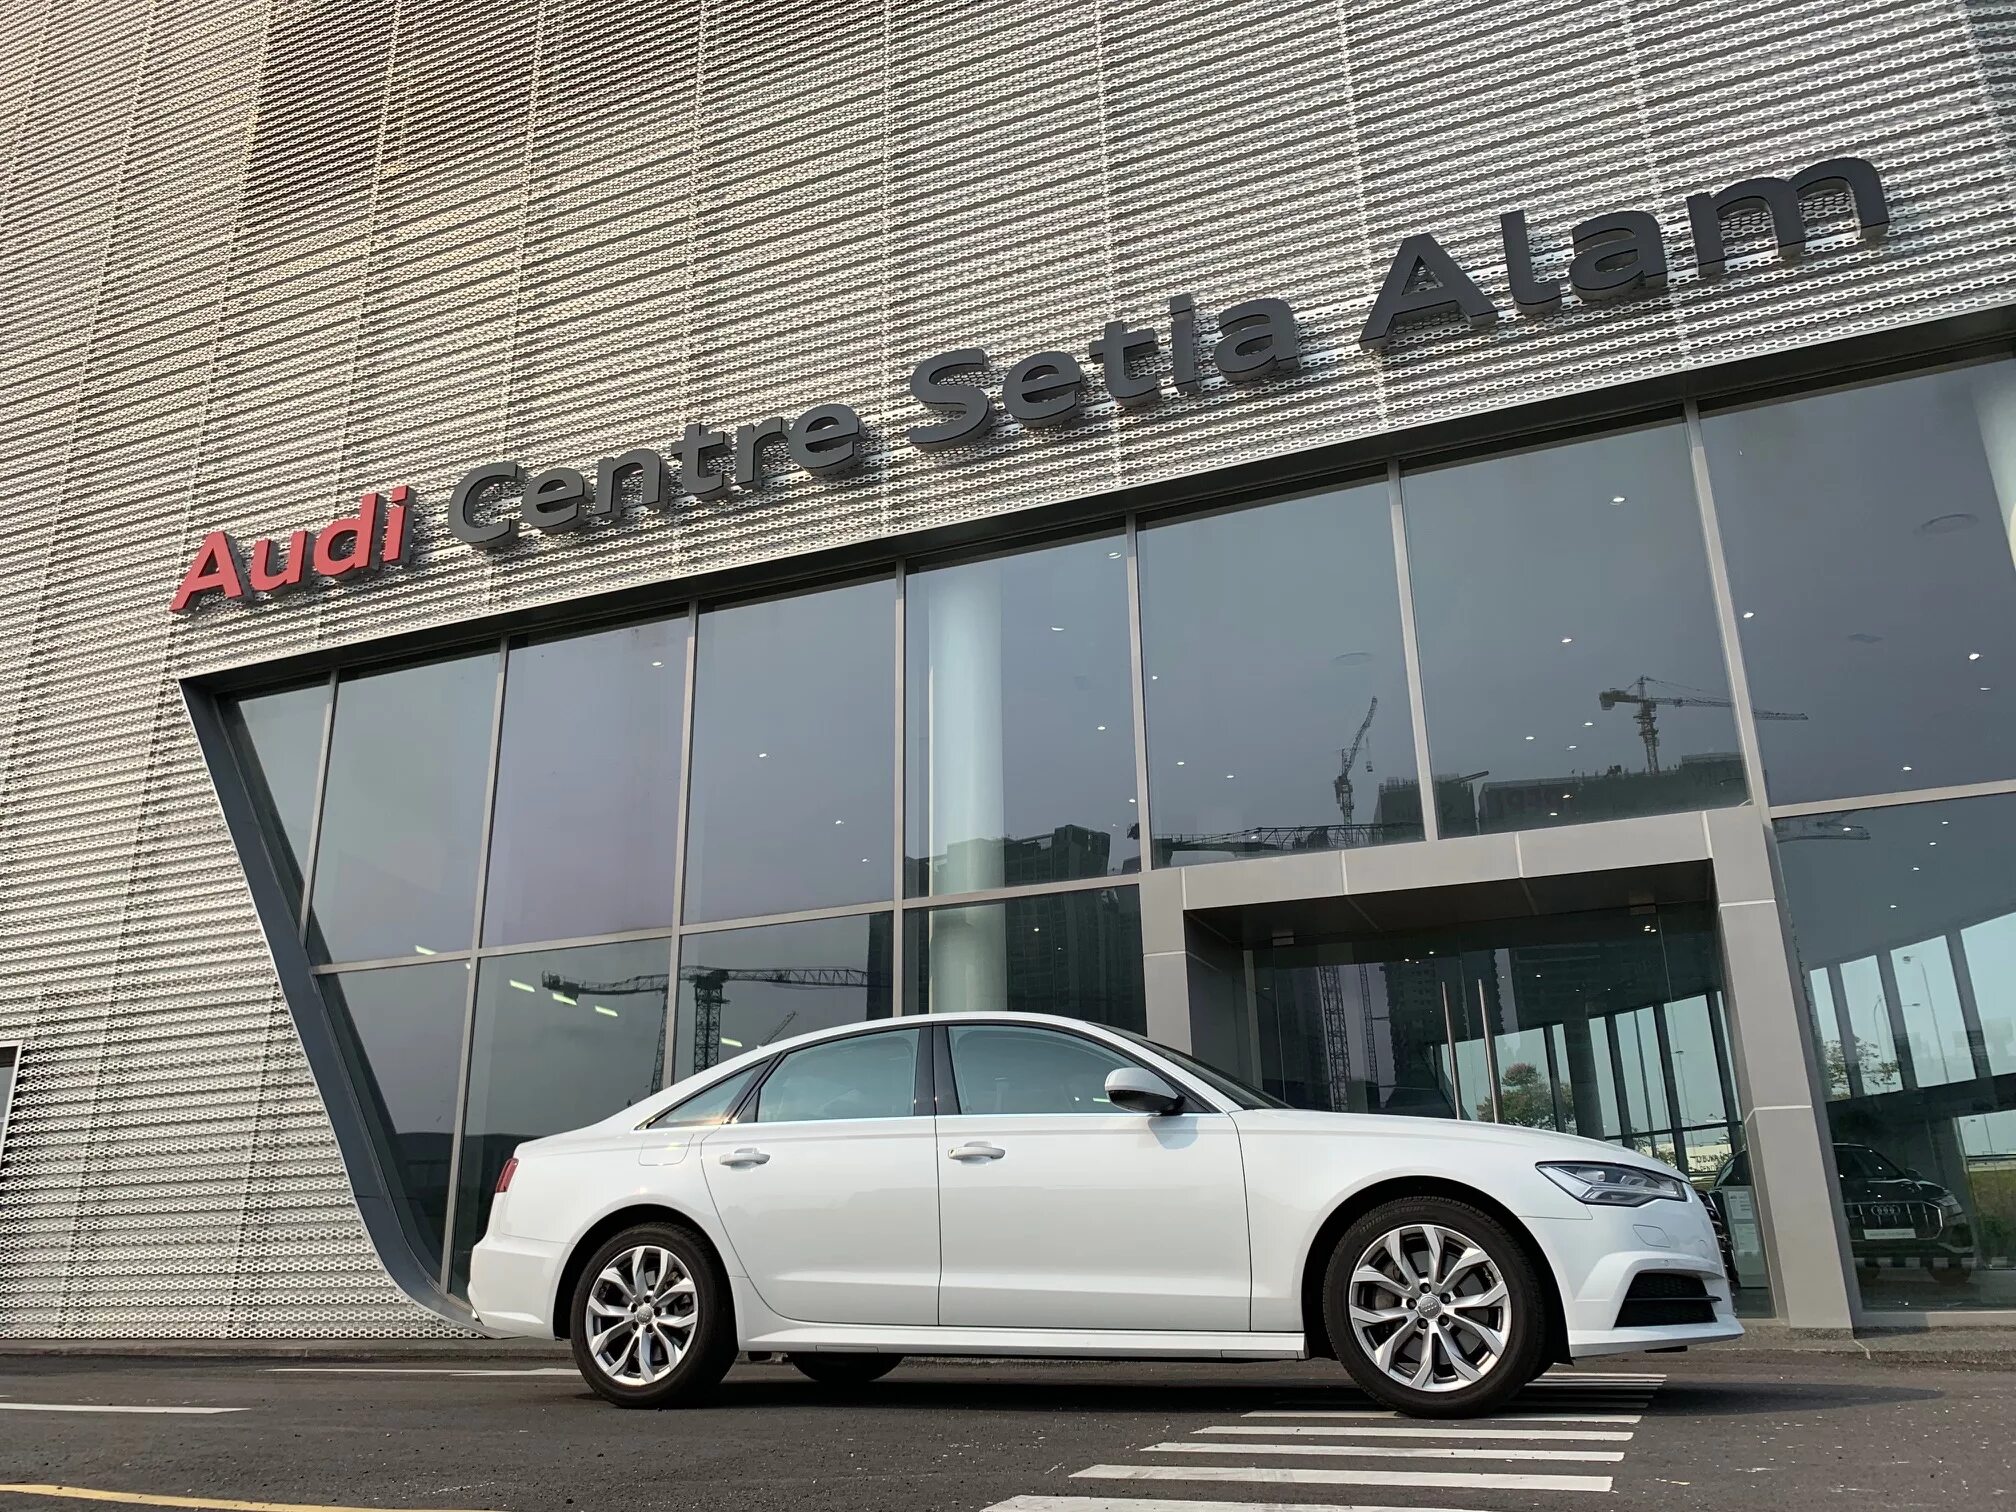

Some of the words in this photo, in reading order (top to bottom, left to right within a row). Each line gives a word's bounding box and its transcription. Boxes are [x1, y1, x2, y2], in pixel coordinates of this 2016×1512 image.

[169, 485, 414, 612] Audi
[448, 404, 866, 546] Centre
[909, 294, 1301, 450] Setia
[1360, 157, 1890, 352] Alam
